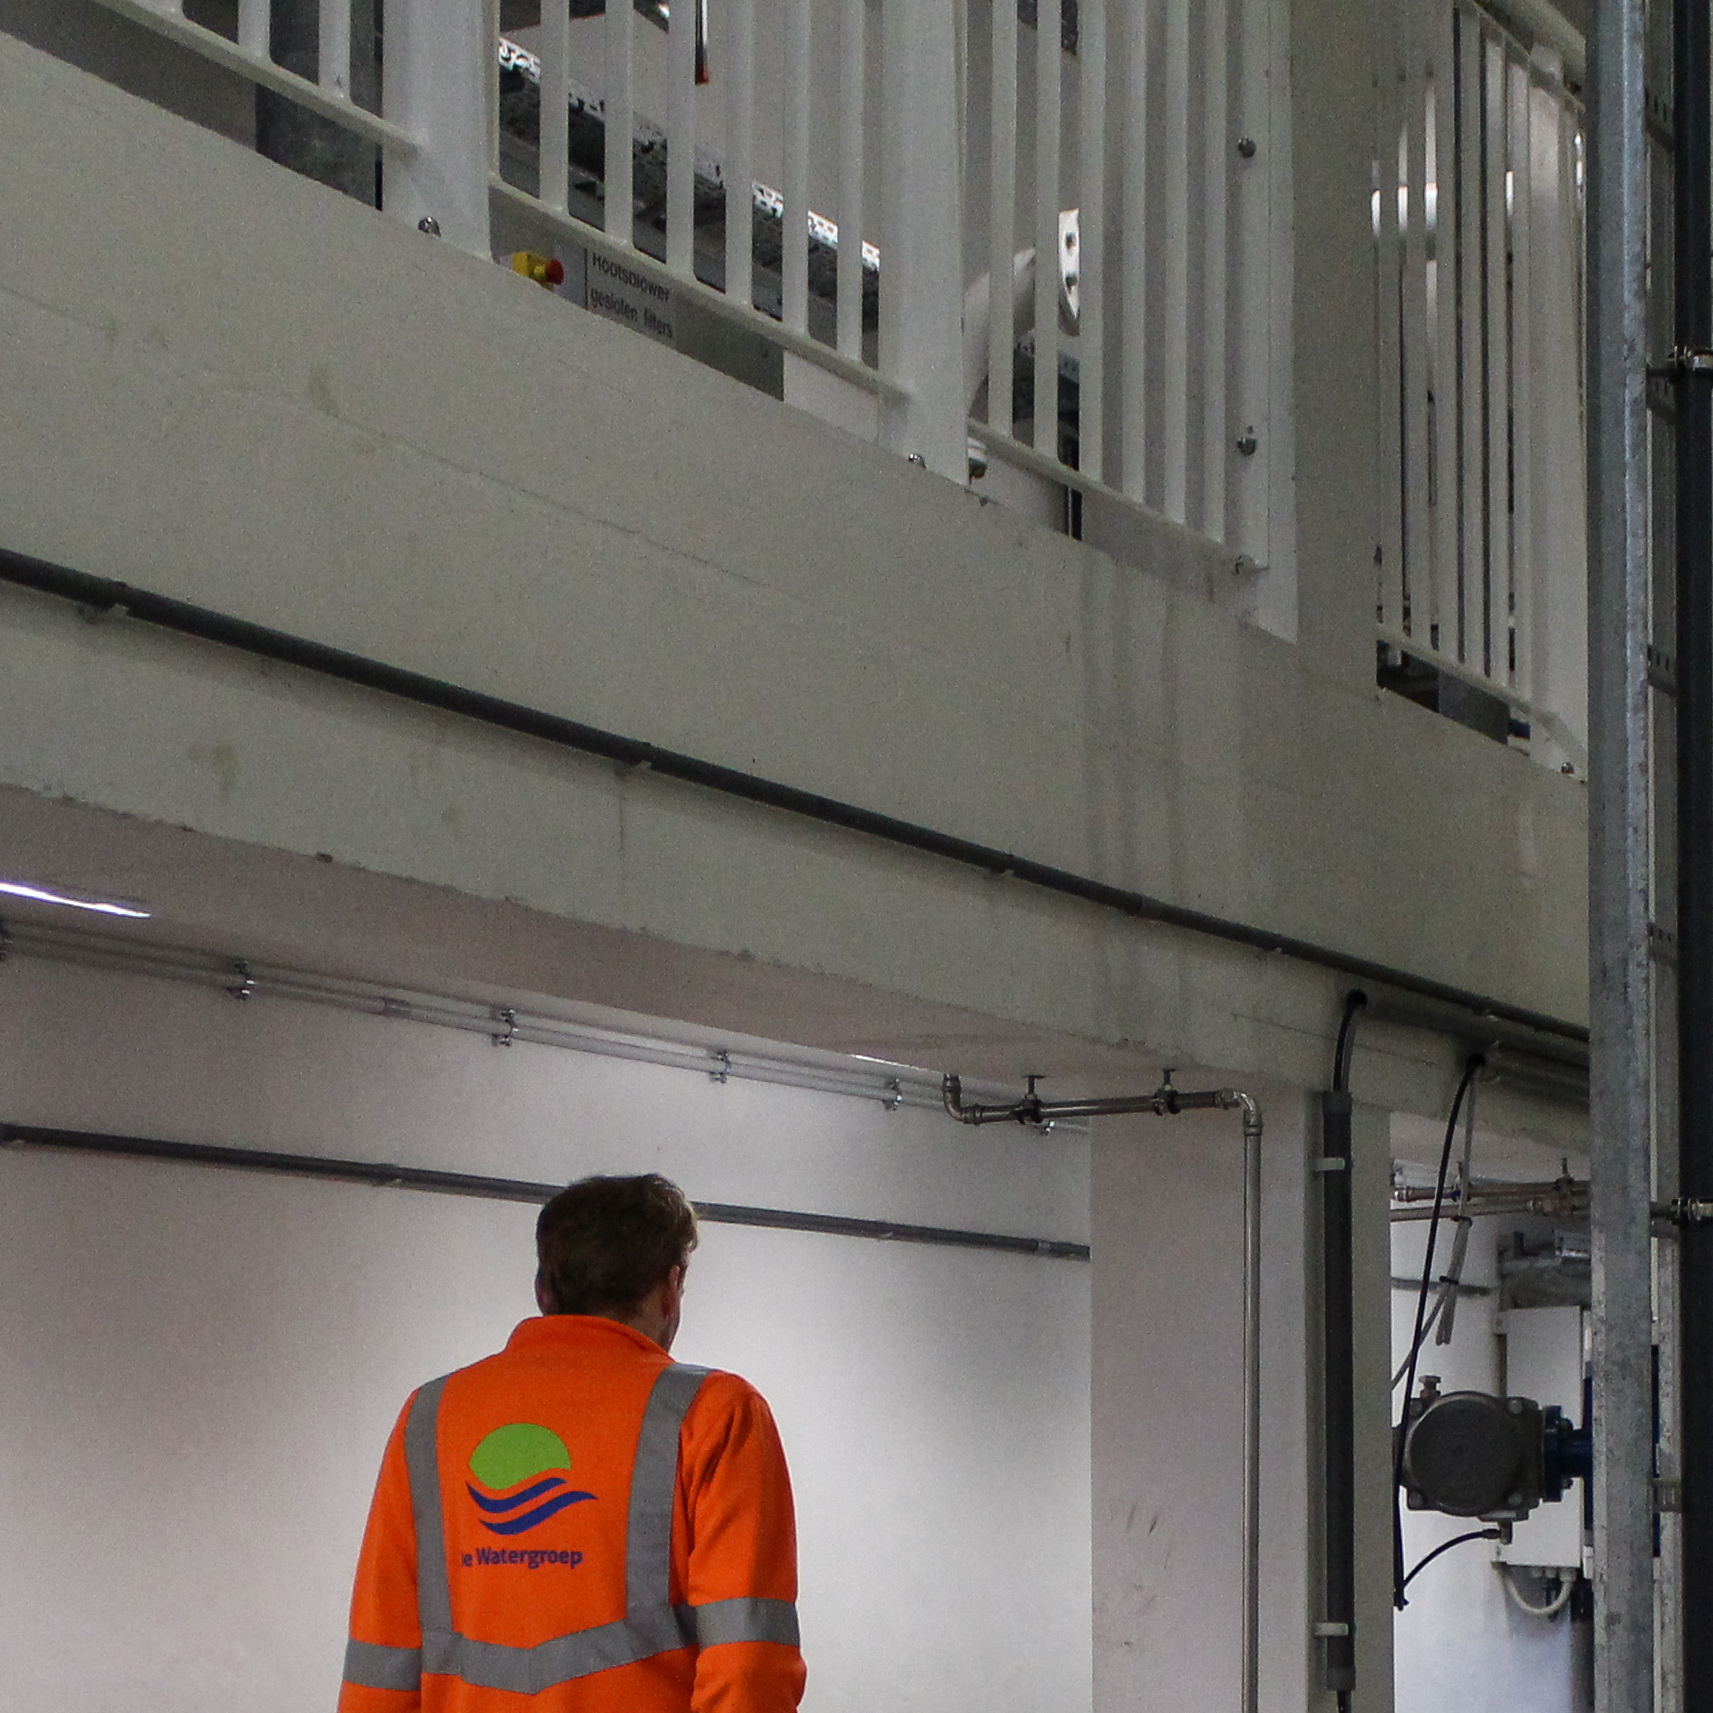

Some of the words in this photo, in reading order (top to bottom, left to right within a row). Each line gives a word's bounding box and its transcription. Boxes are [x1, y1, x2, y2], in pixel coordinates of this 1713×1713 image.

[590, 288, 638, 324] gesloten
[644, 308, 674, 339] filters
[475, 1547, 584, 1570] Watergroep
